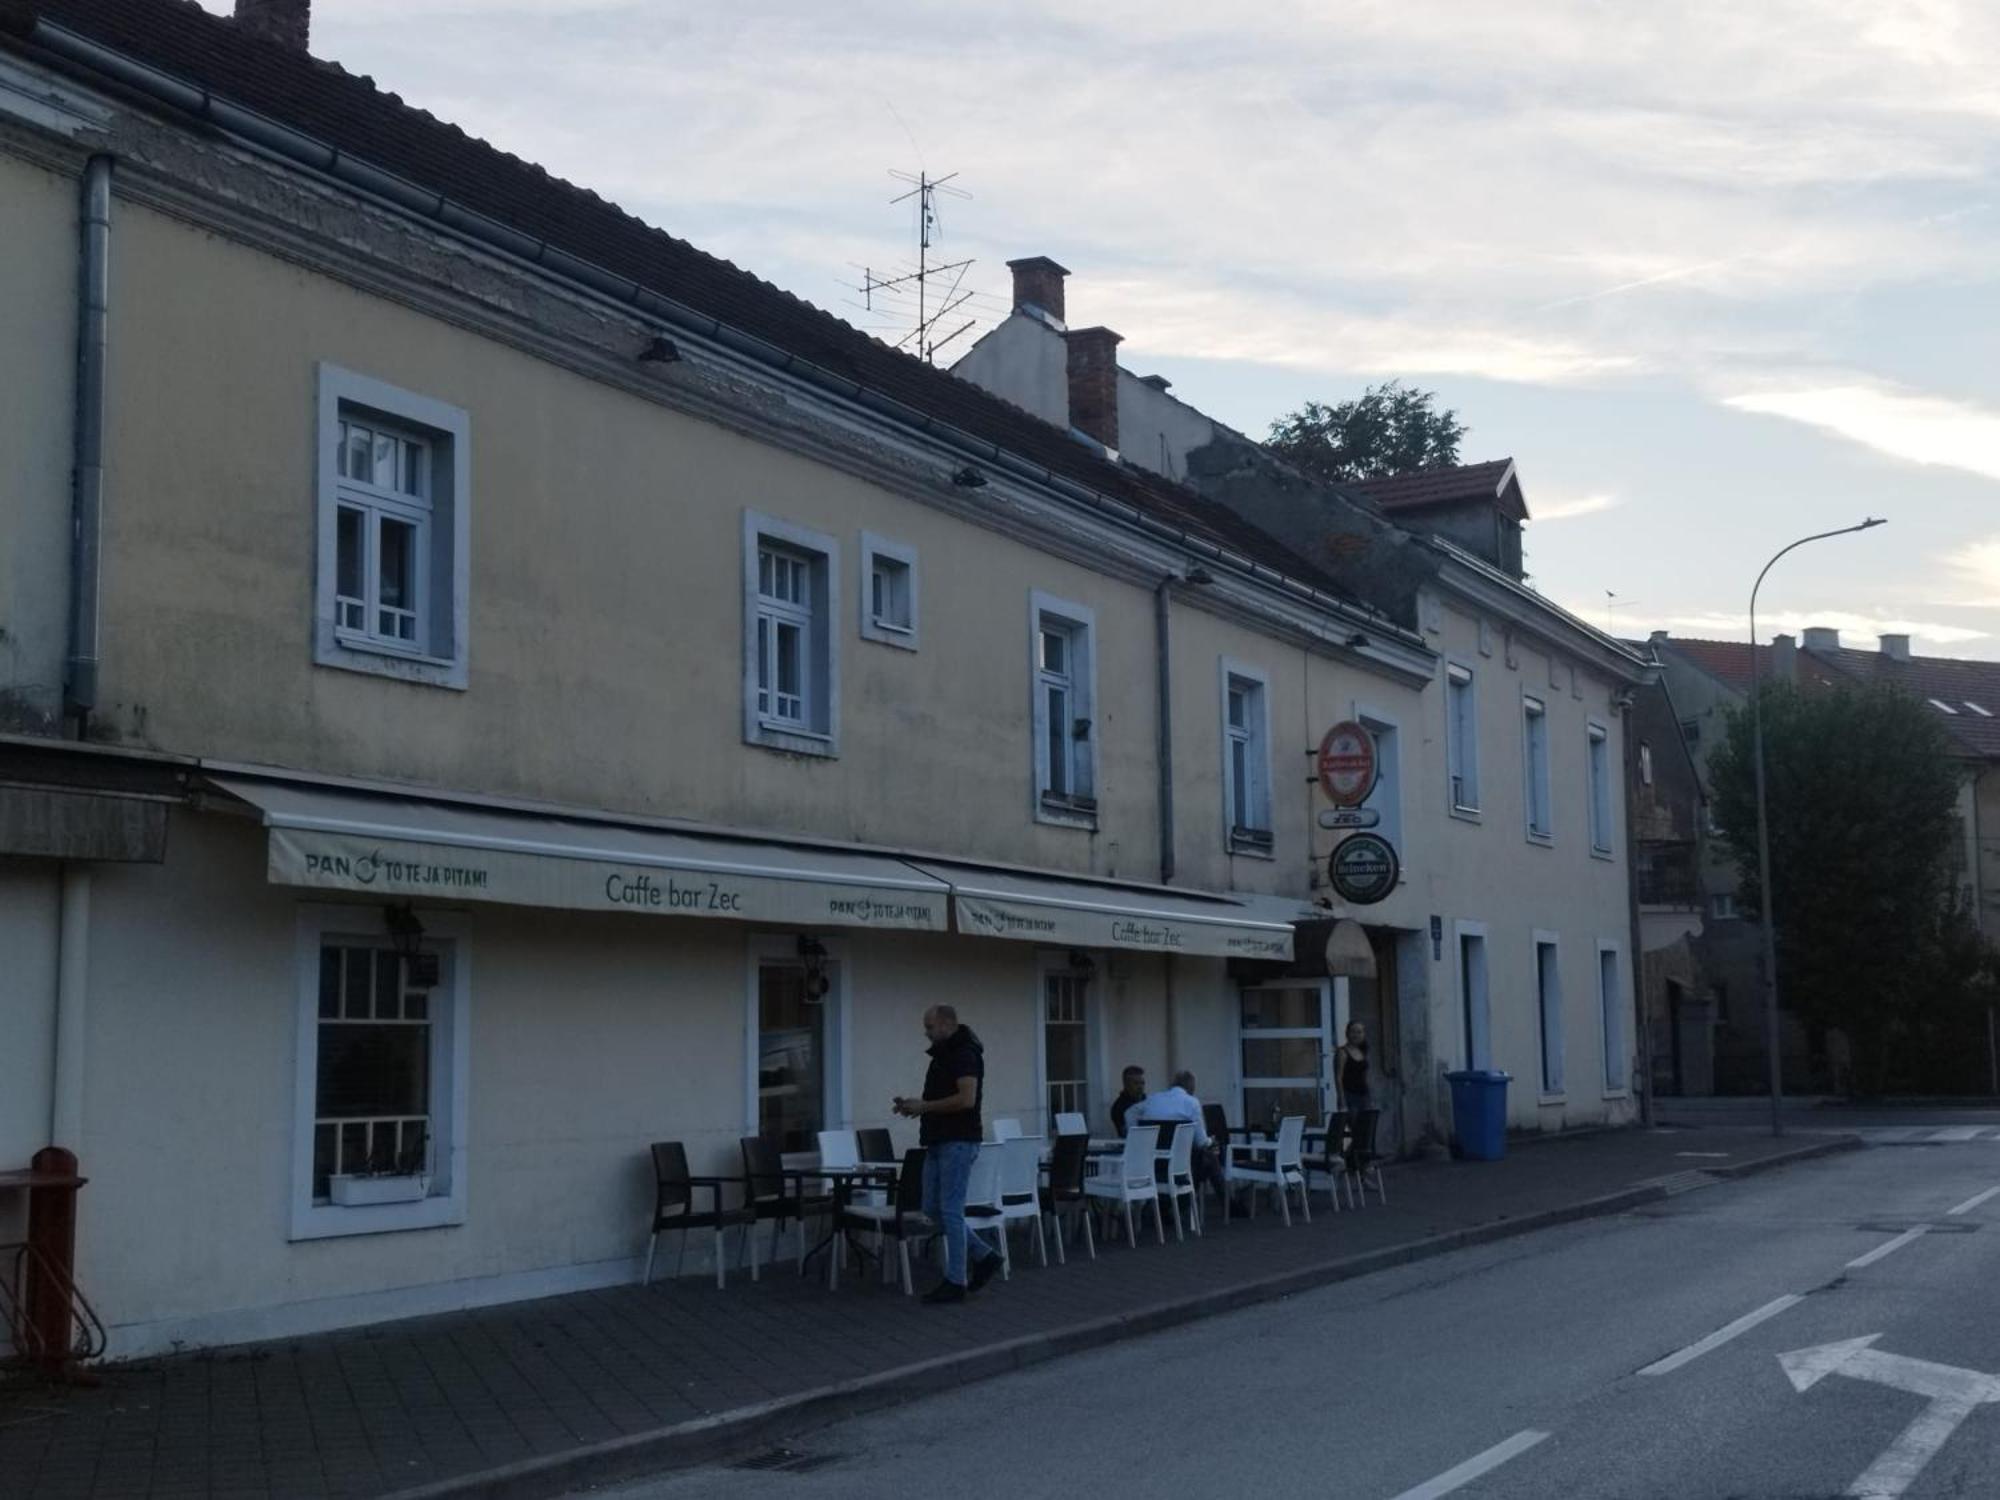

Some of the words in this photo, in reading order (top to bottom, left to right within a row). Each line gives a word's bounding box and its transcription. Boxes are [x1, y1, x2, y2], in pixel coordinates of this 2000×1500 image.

[305, 854, 350, 876] PAN
[385, 862, 403, 881] TO
[406, 864, 420, 882] TE
[422, 866, 439, 885] JA
[444, 866, 488, 888] PITAM!
[1338, 863, 1387, 874] Heineken
[606, 873, 661, 906] Caffe
[668, 878, 702, 908] bar
[708, 883, 741, 911] Zec
